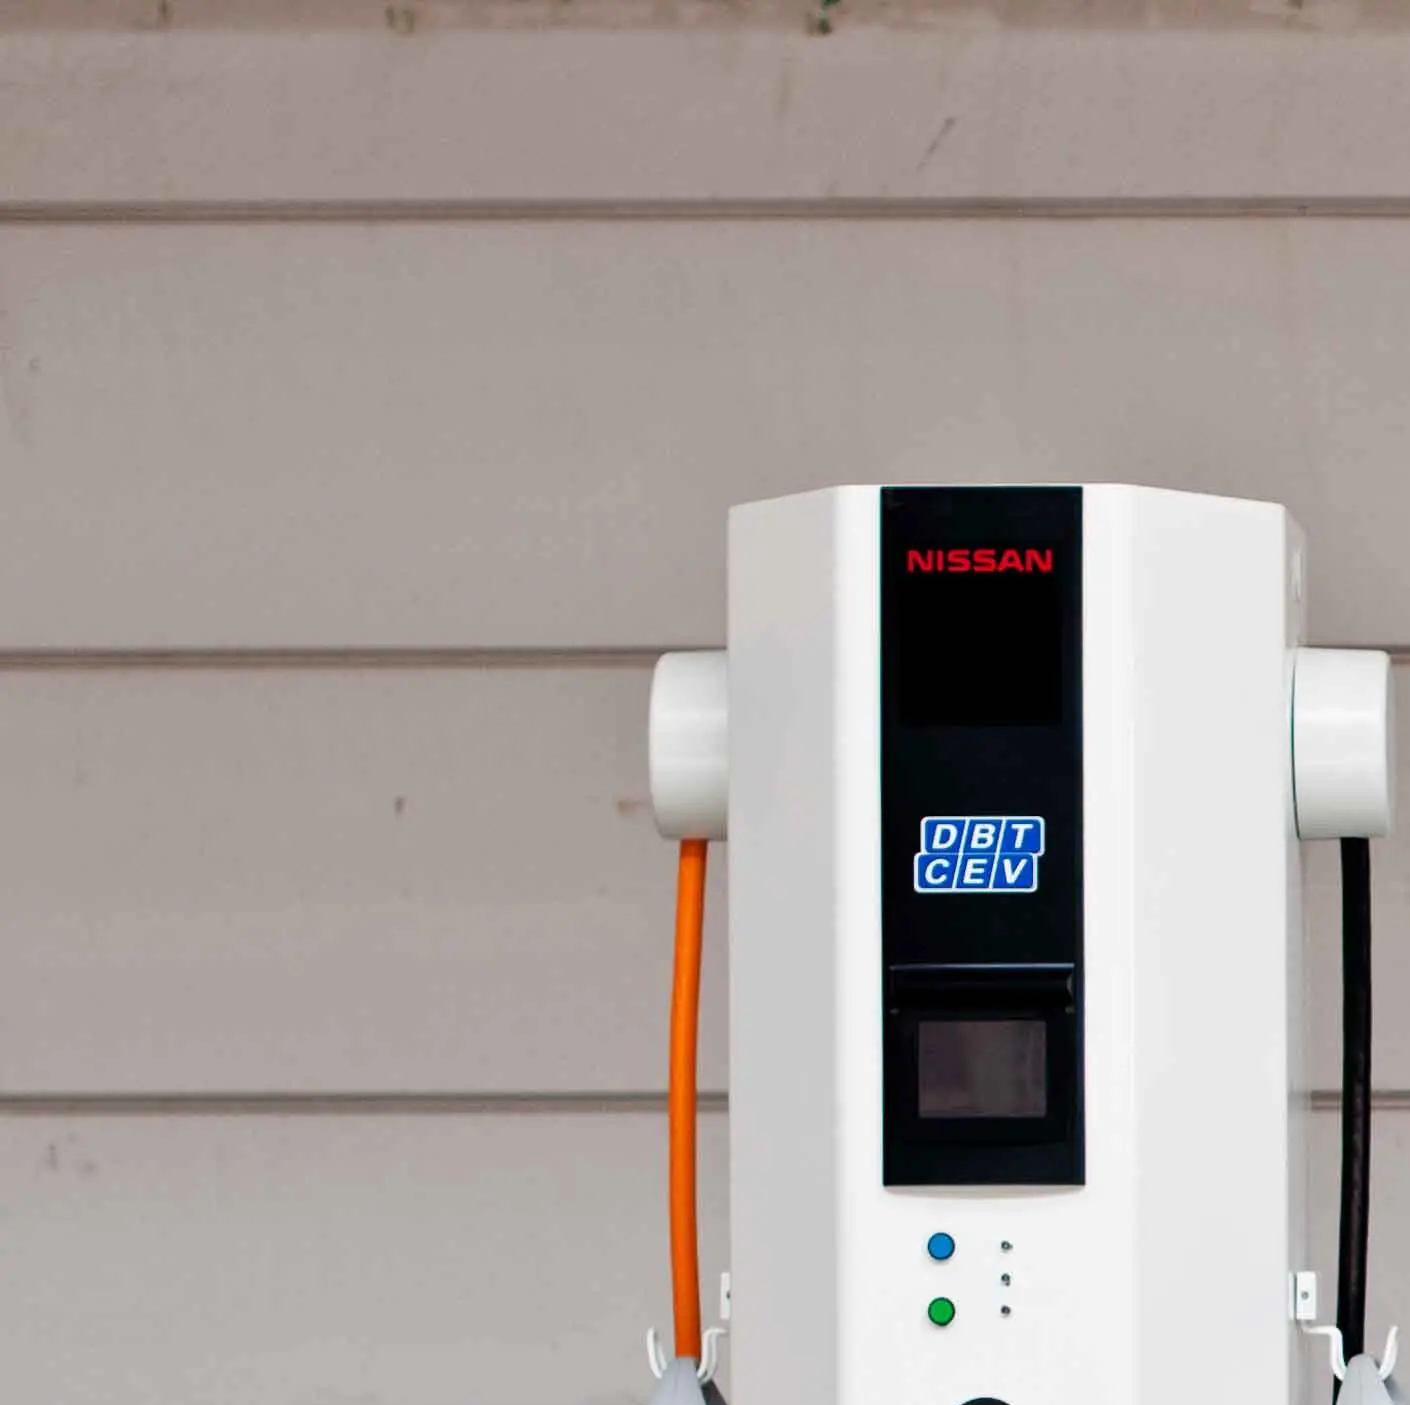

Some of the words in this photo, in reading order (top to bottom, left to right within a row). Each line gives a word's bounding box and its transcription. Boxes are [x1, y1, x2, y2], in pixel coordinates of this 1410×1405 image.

[907, 549, 1053, 573] NISSAN
[932, 823, 1033, 849] DBT
[924, 858, 1027, 884] CEV
